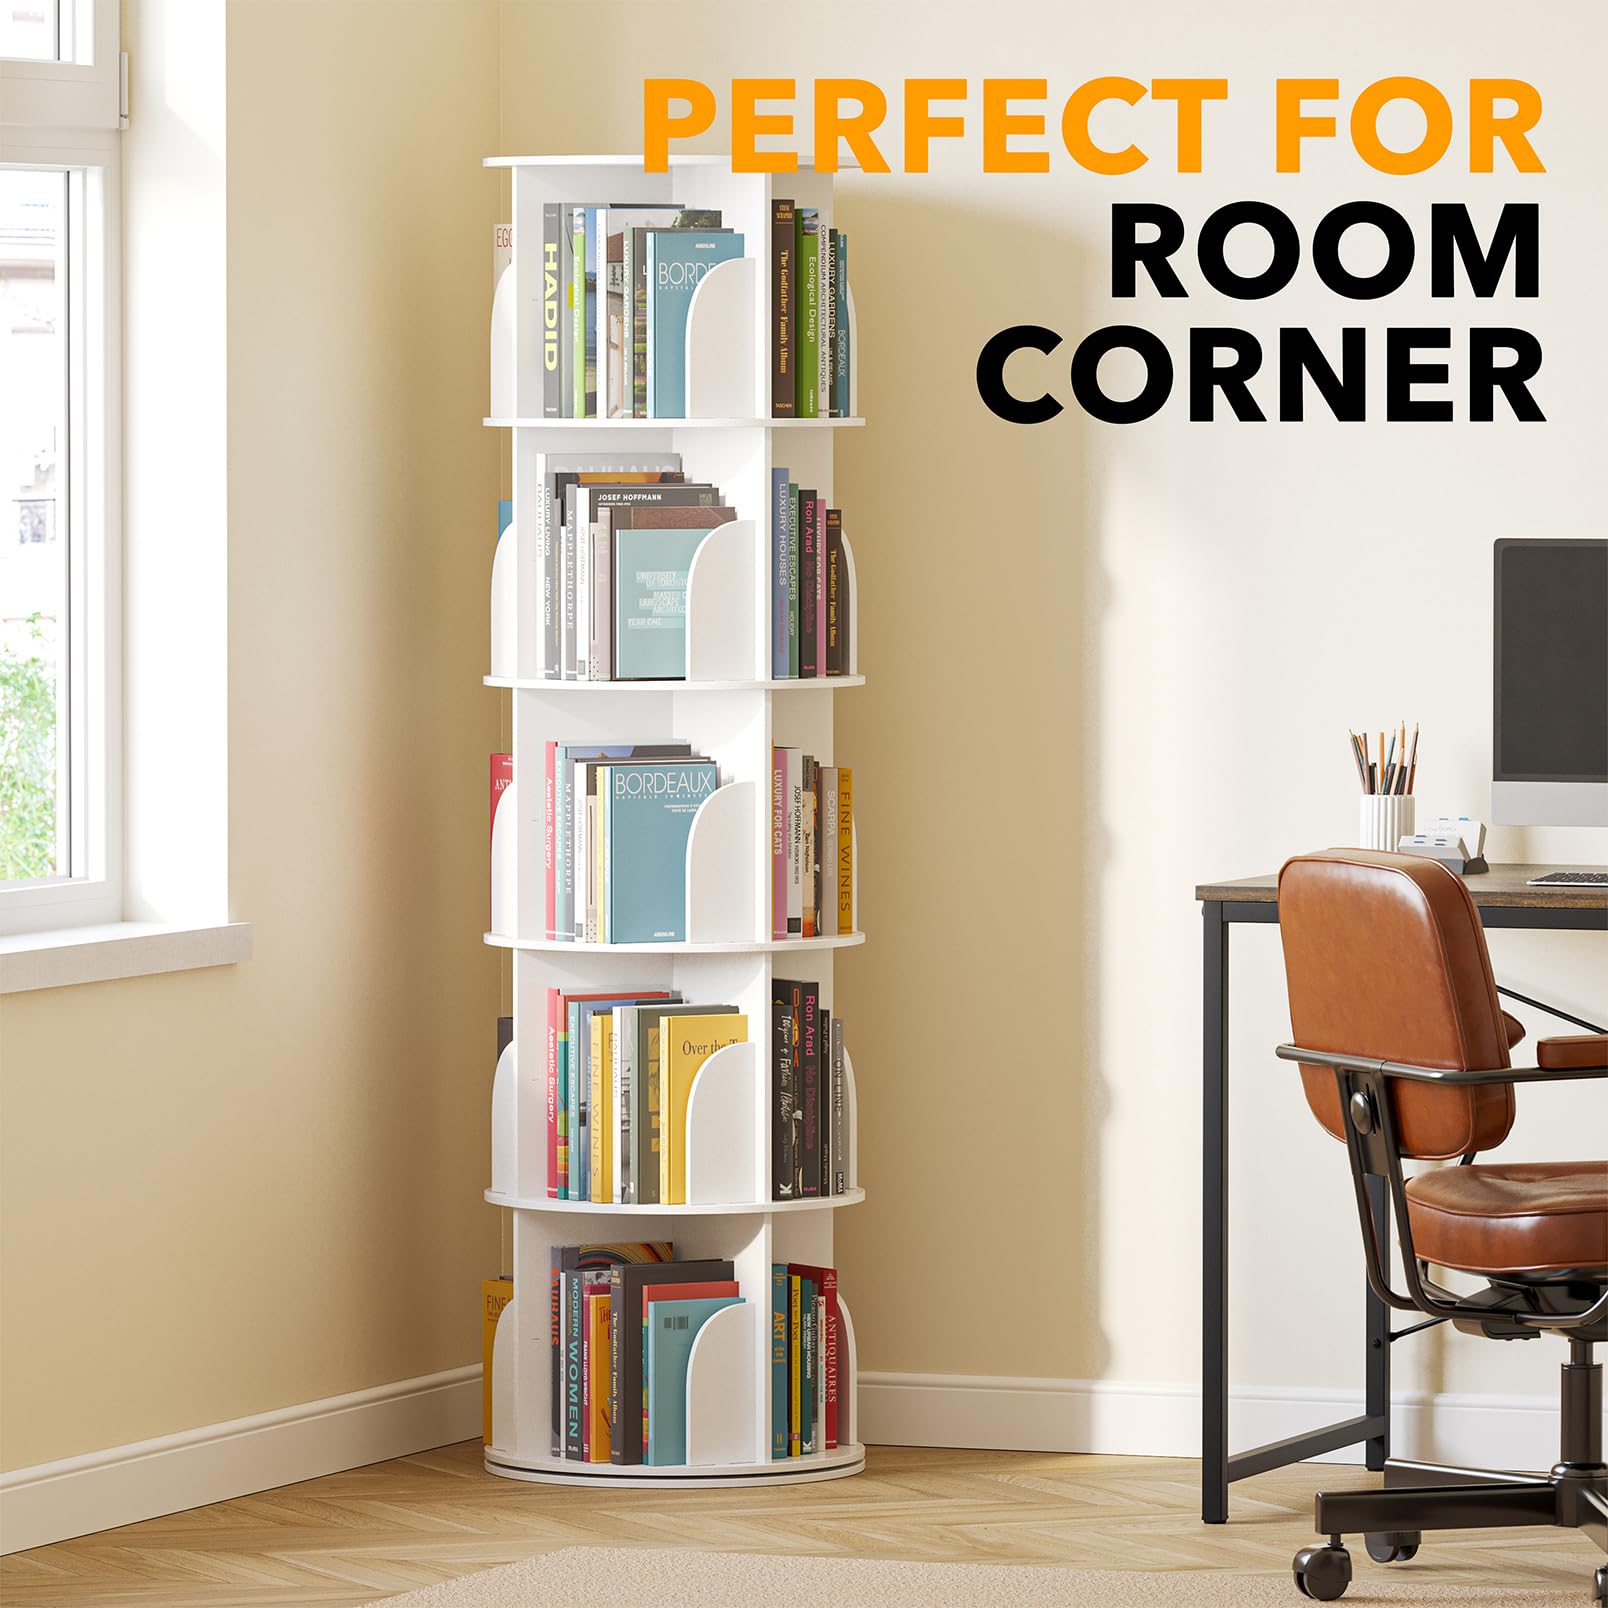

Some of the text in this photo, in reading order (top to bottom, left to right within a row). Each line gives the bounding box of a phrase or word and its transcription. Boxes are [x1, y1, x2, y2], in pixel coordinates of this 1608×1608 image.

[544, 243, 558, 372] HADID
[780, 249, 789, 374] The Godfather Family Album
[806, 255, 817, 343] Ecological Design
[838, 329, 846, 377] BORDEAUX
[597, 493, 662, 502] JOSEF HOFFMANN
[805, 500, 814, 524] Ron
[788, 497, 796, 552] EXECUTIVE
[805, 526, 814, 553] Arad
[788, 554, 796, 601] ESCAPES
[615, 771, 713, 795] BORDEAUX
[774, 769, 782, 855] LUXURY FOR CATS
[827, 789, 835, 836] SCARPA
[841, 791, 850, 912] FINE WINES
[805, 994, 815, 1020] Ron
[682, 1040, 708, 1056] Over
[805, 1024, 815, 1056] Arad
[773, 1311, 784, 1341] ART
[569, 1340, 578, 1438] WOMEN
